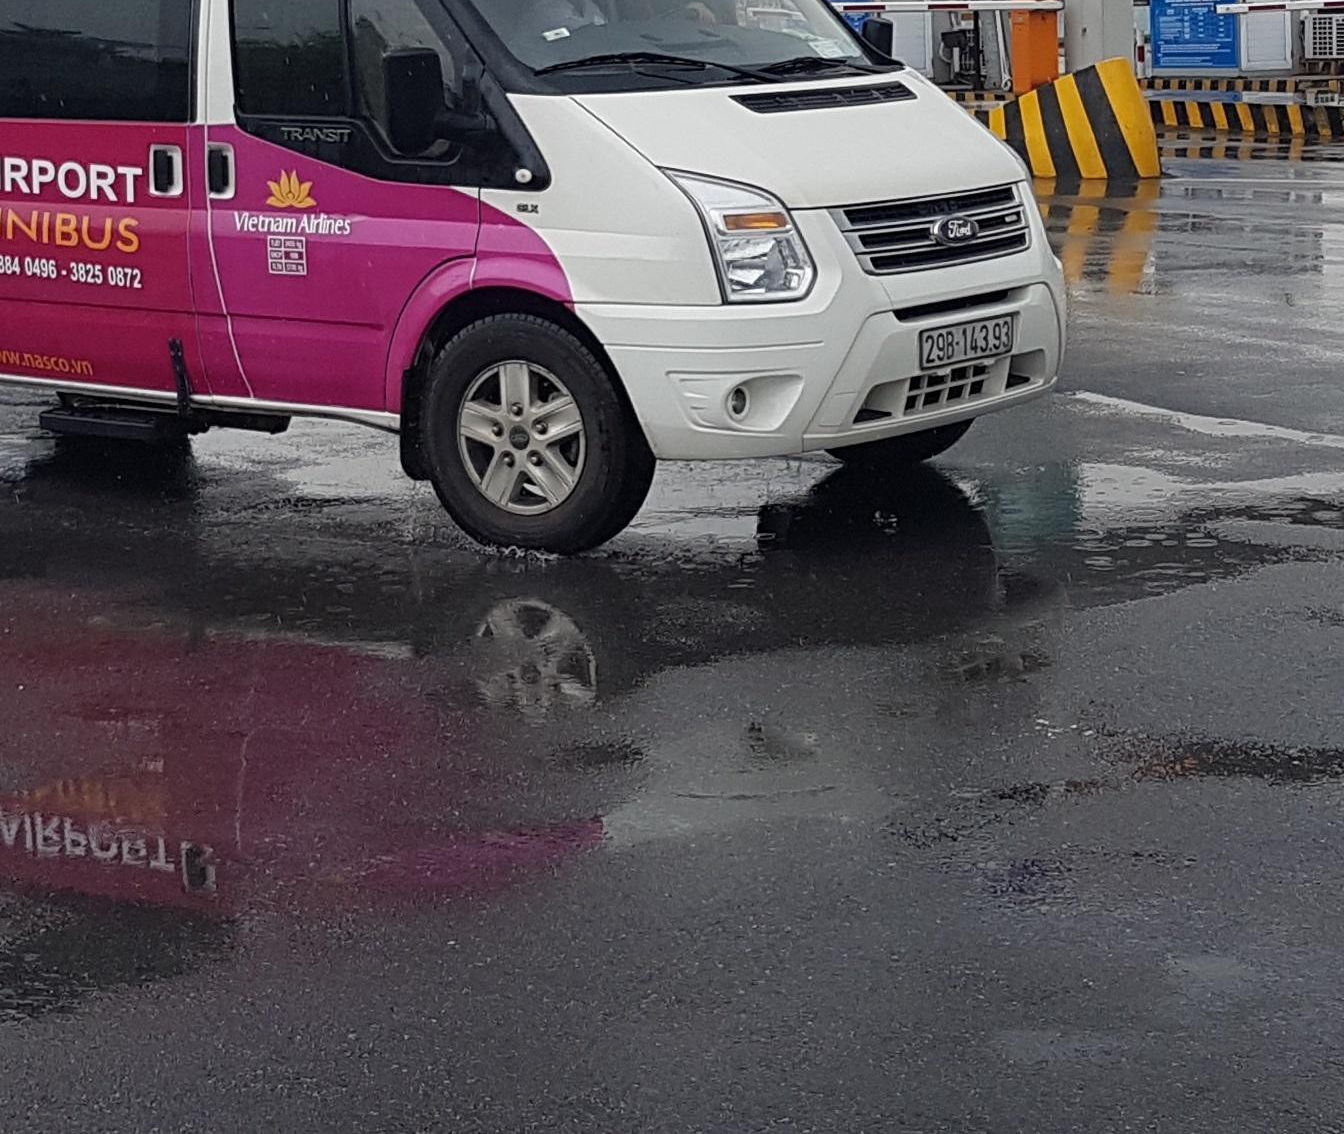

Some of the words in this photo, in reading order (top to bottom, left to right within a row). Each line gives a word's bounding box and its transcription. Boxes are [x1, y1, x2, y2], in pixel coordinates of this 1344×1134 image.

[280, 127, 351, 142] TRANSIT
[234, 211, 296, 233] Vietnam
[298, 213, 351, 235] Airlines
[948, 220, 971, 238] Ford
[24, 257, 57, 279] 0496
[70, 262, 103, 284] 3825
[108, 266, 143, 288] 0872
[925, 321, 1010, 364] 29B-143.93
